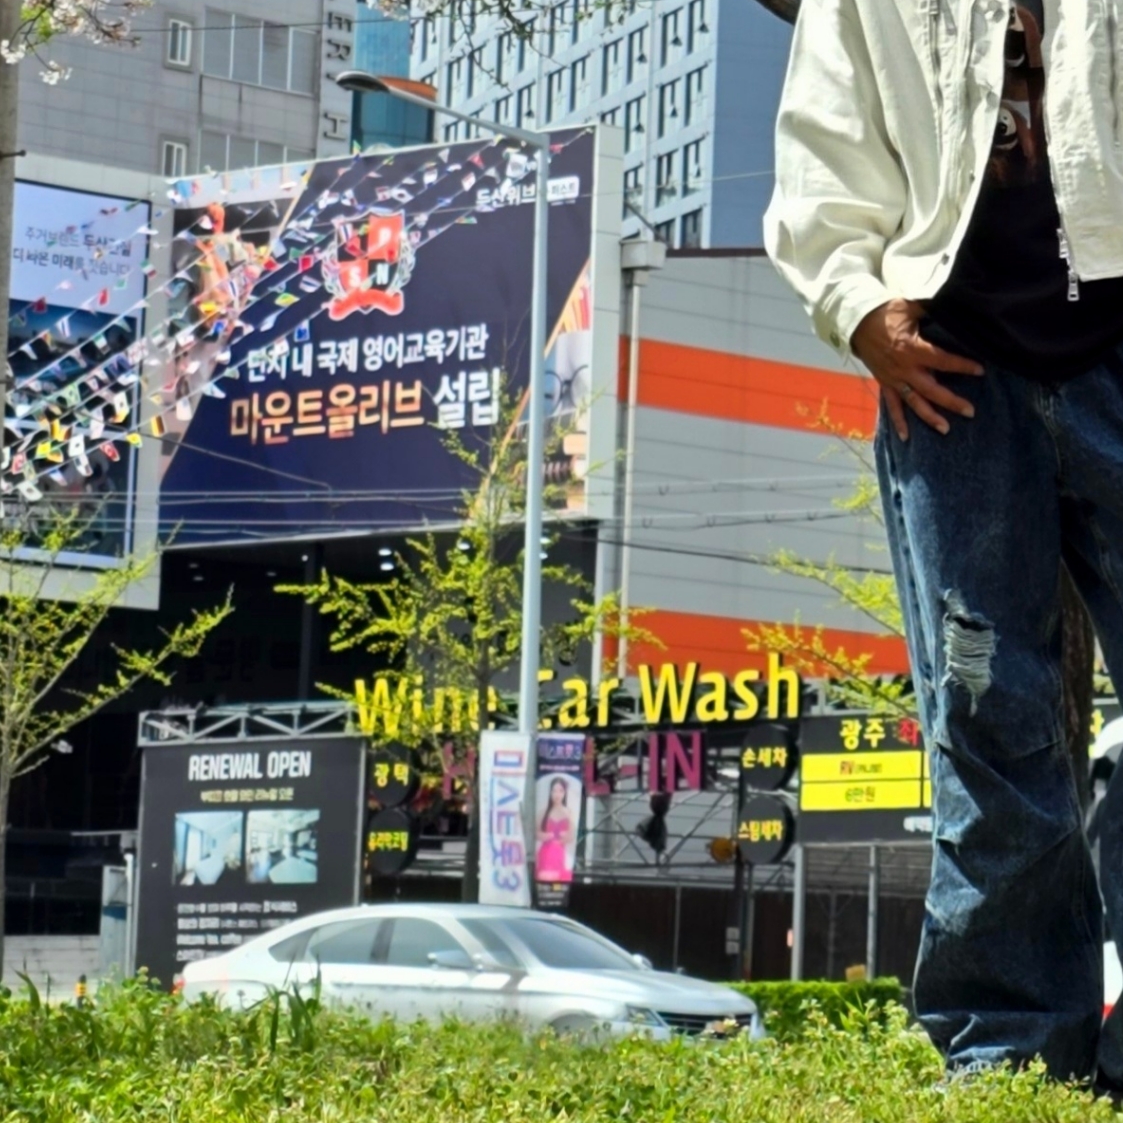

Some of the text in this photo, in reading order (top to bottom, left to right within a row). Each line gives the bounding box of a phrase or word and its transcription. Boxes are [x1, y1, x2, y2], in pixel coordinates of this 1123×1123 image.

[292, 342, 313, 377] 내
[317, 337, 359, 375] 국제
[362, 323, 489, 372] 영어교육기관
[230, 366, 501, 445] 마운트올리브 설립
[638, 652, 799, 725] Wash
[840, 718, 885, 750] 광주
[188, 750, 312, 781] RENEWAL OPEN
[742, 747, 787, 768] 손세차
